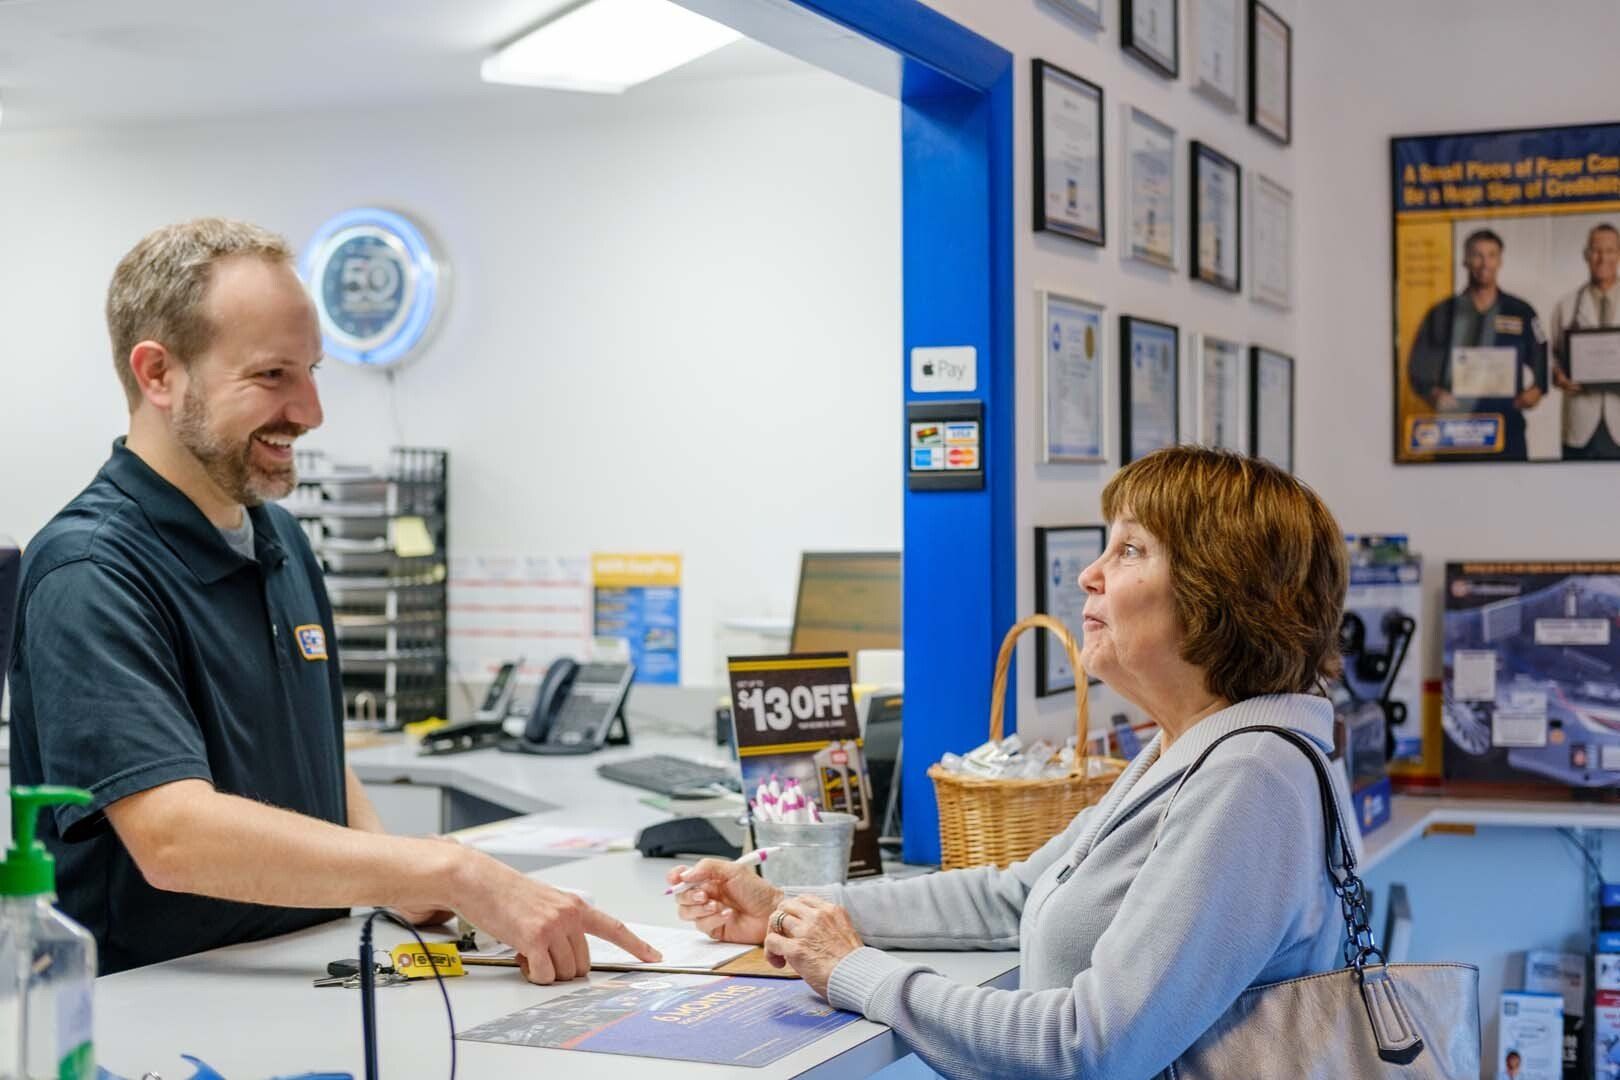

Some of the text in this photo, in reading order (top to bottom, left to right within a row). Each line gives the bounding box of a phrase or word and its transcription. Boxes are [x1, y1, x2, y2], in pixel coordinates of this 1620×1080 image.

[1404, 164, 1416, 183] A
[1419, 162, 1462, 183] Small
[1466, 160, 1512, 180] Piece
[1515, 158, 1533, 178] of
[1536, 156, 1583, 177] Paper
[1404, 186, 1426, 206] Be
[1443, 183, 1483, 205] Huge
[1487, 181, 1521, 203] Sign
[1524, 178, 1542, 199] of
[937, 360, 966, 379] Pay
[737, 684, 849, 731] $13 OFF
[664, 984, 757, 1017] MONTHS
